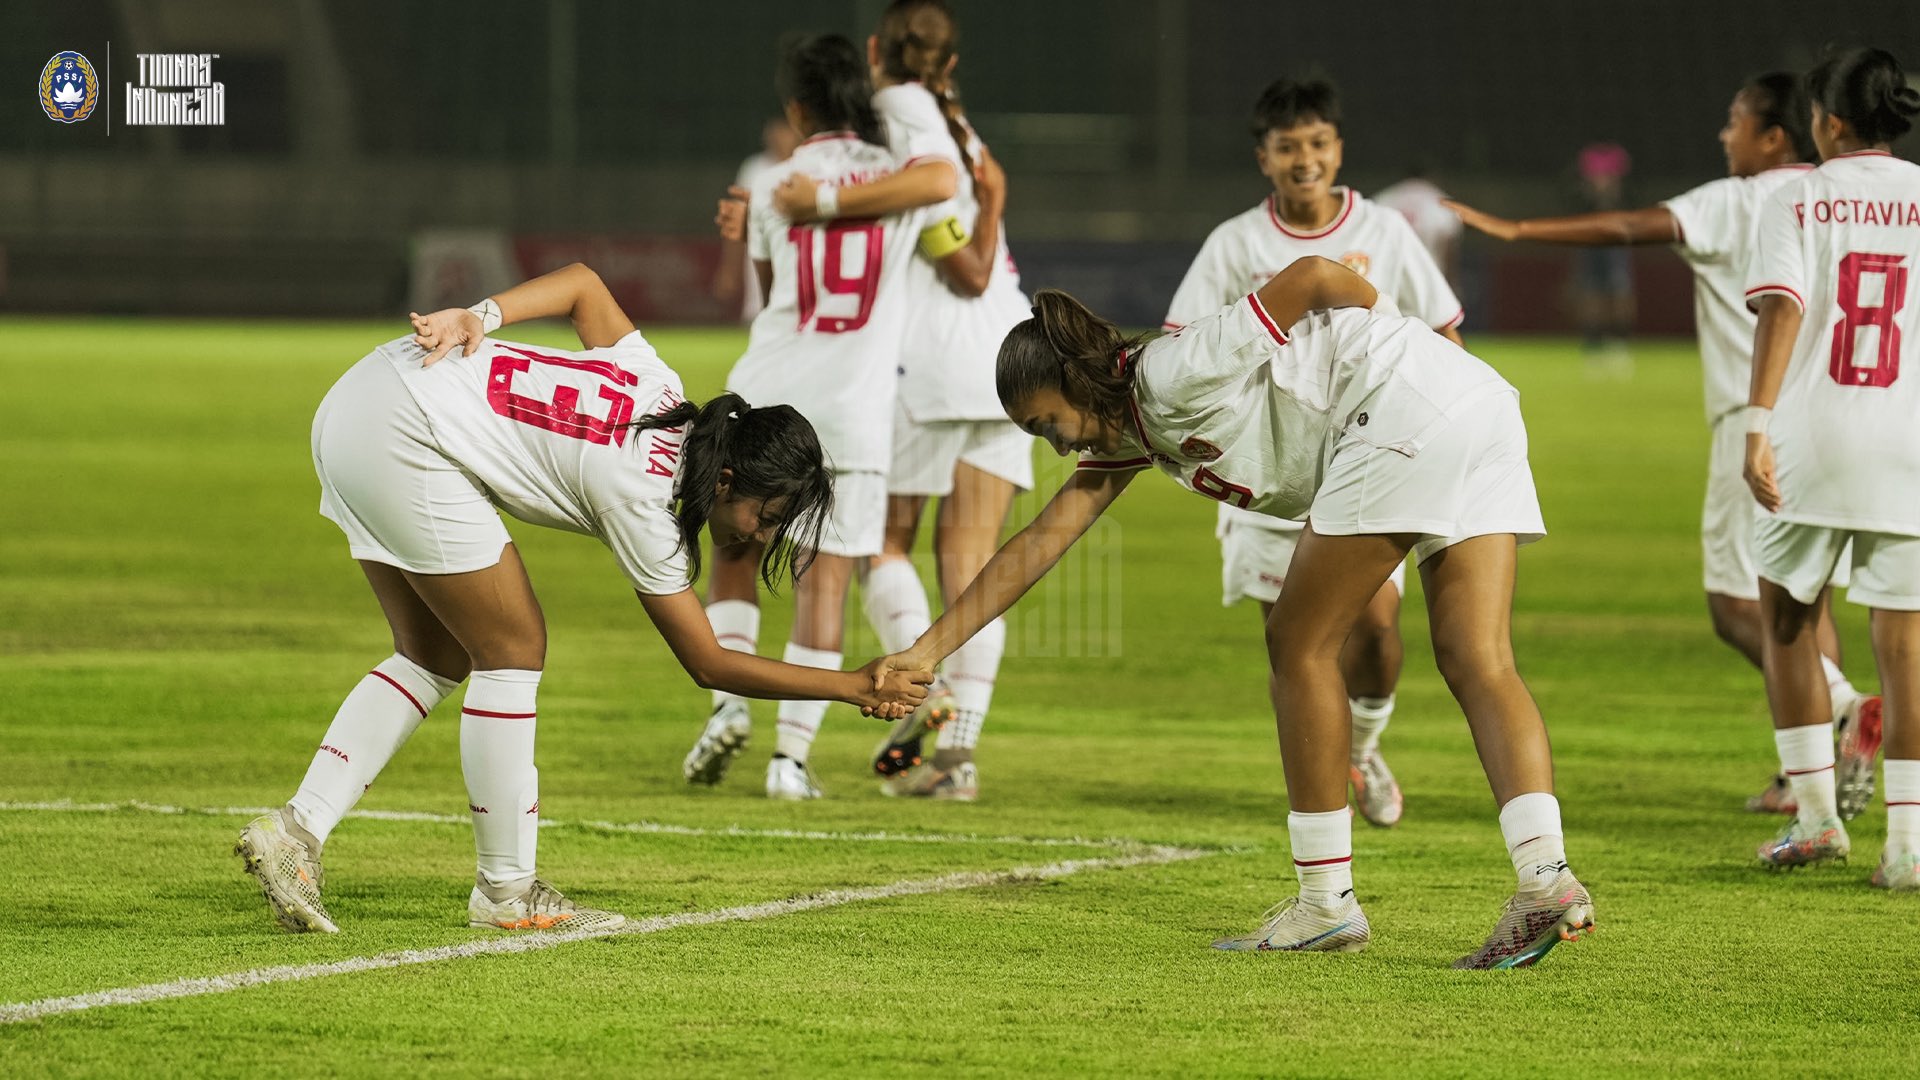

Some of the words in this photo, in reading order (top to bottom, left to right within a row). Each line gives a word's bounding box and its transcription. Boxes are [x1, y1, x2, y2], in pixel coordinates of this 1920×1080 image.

[946, 218, 965, 241] C
[1814, 199, 1920, 227] OCTAVIA
[787, 219, 884, 333] 19
[1828, 250, 1908, 389] 8
